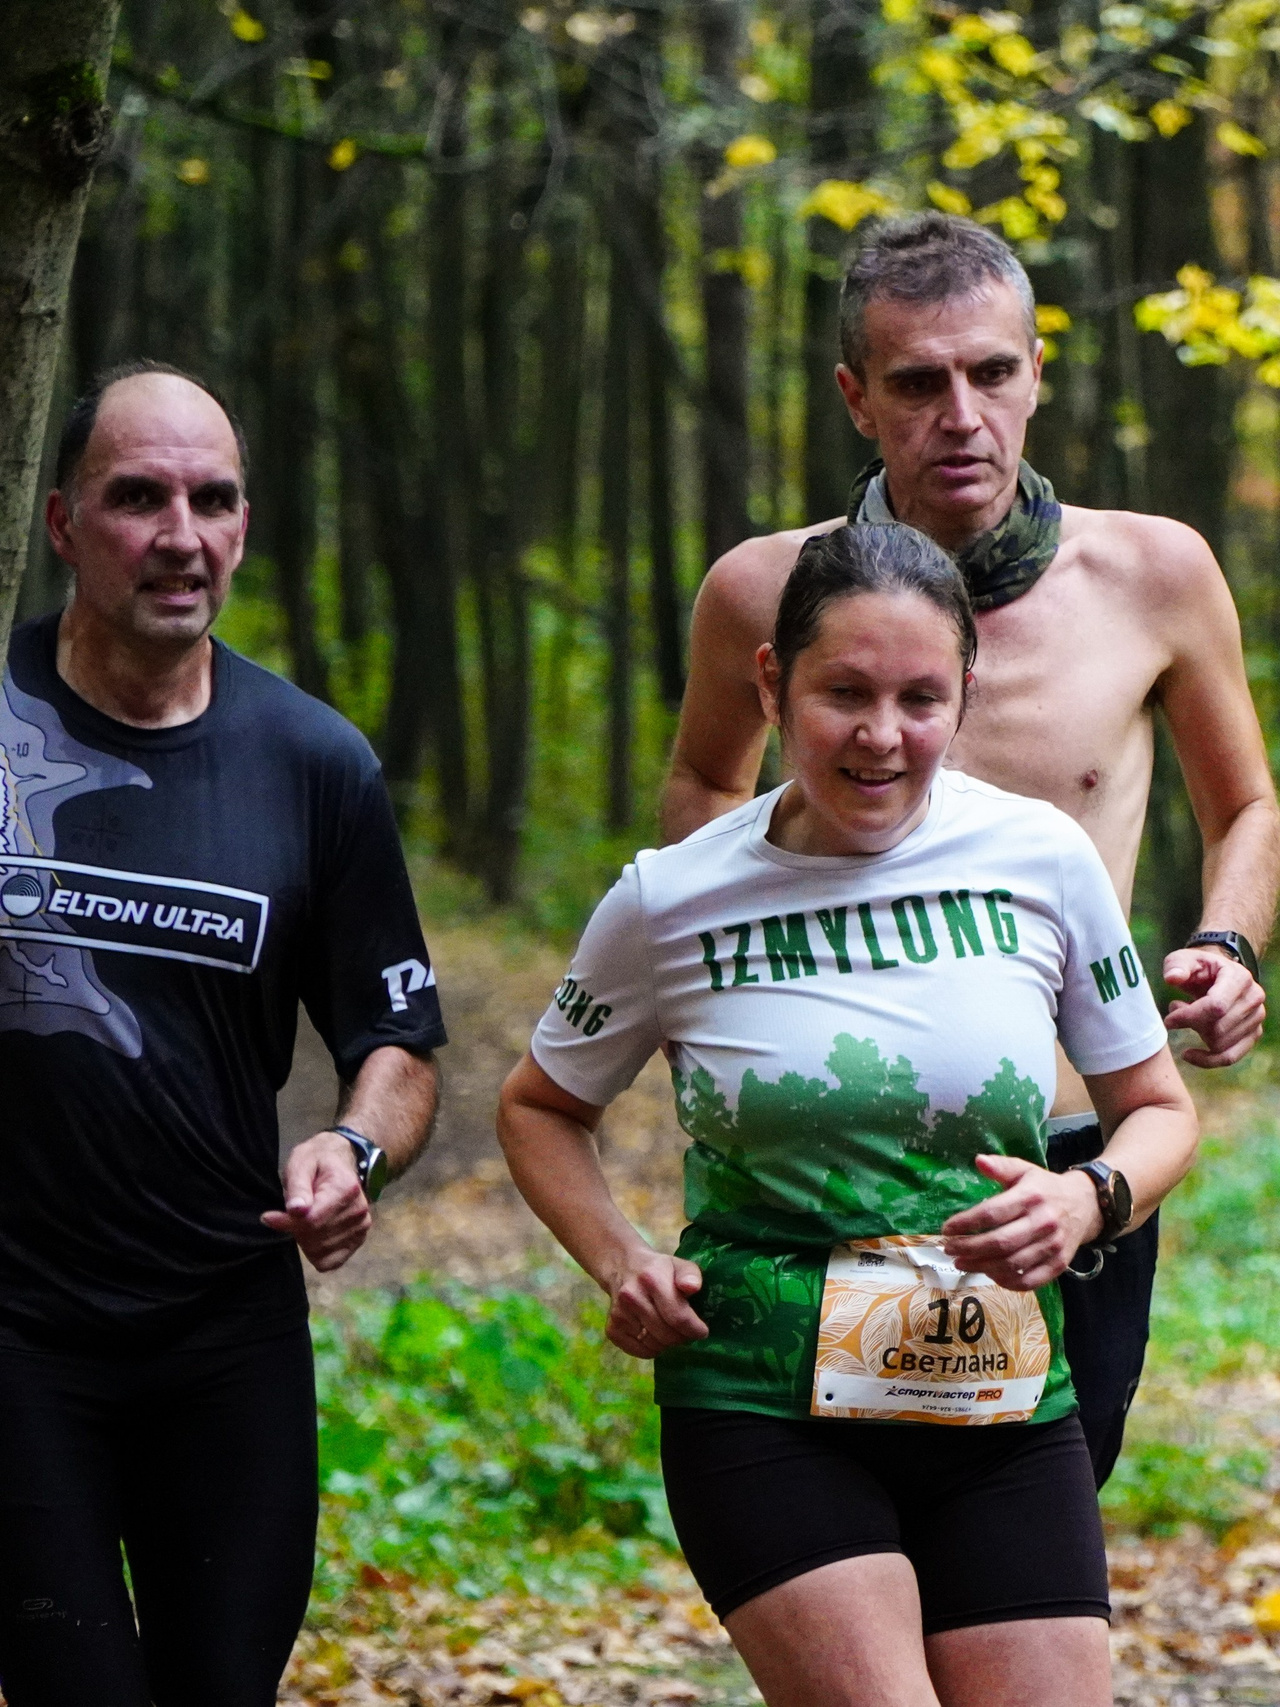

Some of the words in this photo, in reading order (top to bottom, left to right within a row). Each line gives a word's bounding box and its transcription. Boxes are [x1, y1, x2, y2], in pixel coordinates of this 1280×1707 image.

[48, 888, 149, 926] ELTON
[153, 903, 245, 944] ULTRA
[699, 887, 1022, 992] IZMYLONG
[1089, 945, 1146, 1004] MO
[554, 977, 613, 1036] ONG
[923, 1296, 986, 1345] 10
[881, 1347, 1009, 1374] Светлана
[897, 1387, 976, 1401] спортмастер
[976, 1389, 1003, 1400] PRO
